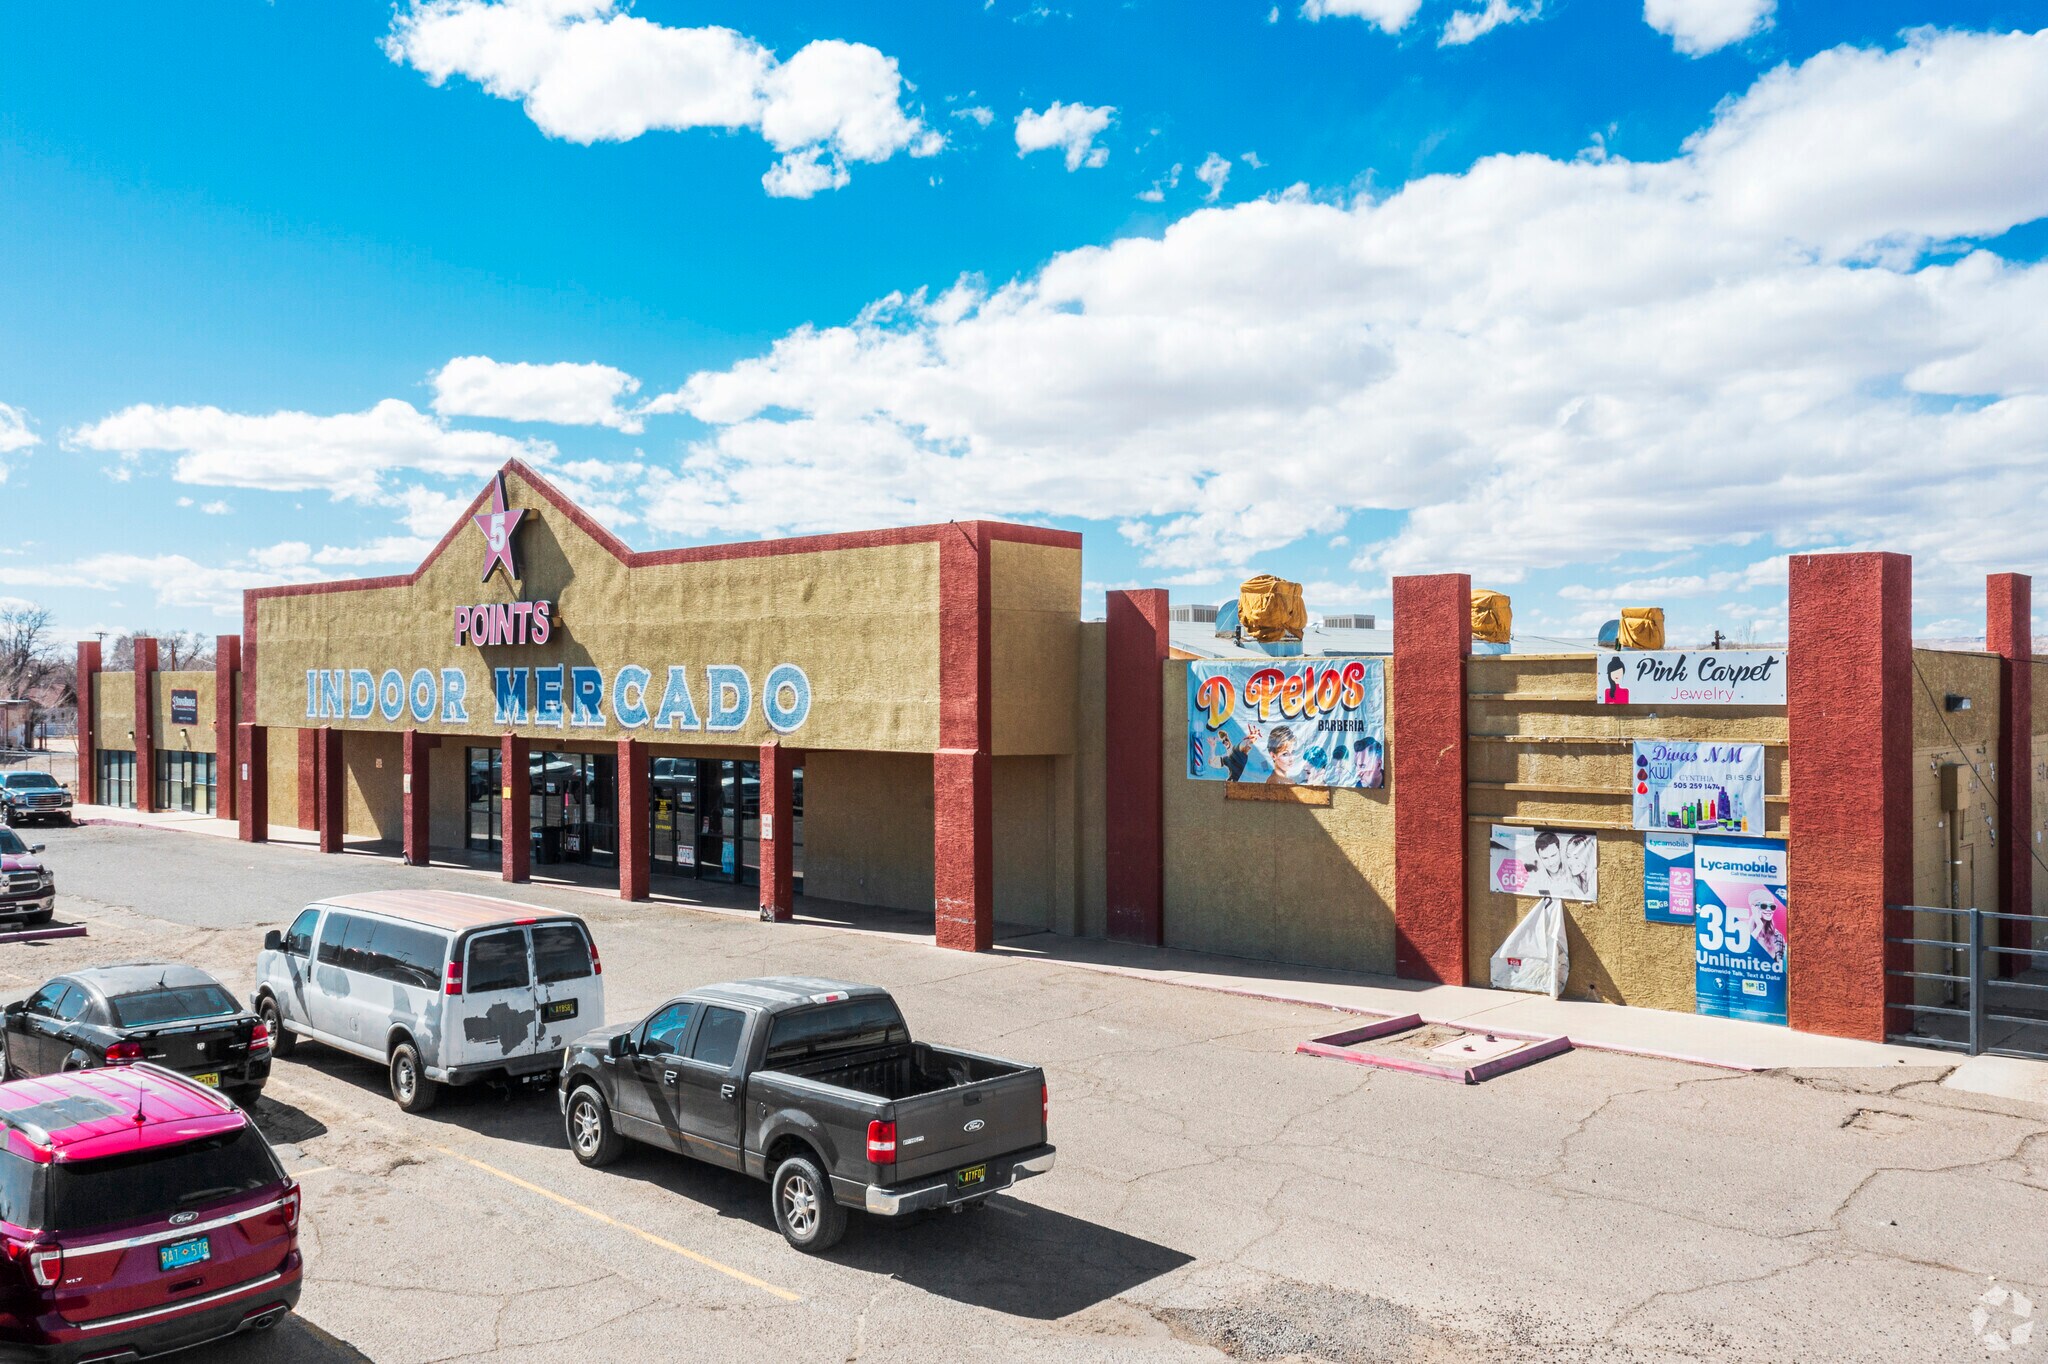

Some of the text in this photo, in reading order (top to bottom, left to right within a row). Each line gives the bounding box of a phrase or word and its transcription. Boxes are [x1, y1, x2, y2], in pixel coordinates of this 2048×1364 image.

[489, 513, 506, 552] 5
[455, 601, 552, 646] POINTS
[1637, 654, 1779, 688] Pink Carpet
[306, 664, 811, 733] INDOOR MERCADO
[1195, 675, 1236, 731] D
[1671, 687, 1735, 702] Jewelry
[1680, 774, 1715, 783] CYNTHIA
[1689, 782, 1703, 790] 259
[1701, 857, 1777, 874] Lycamobile
[1696, 949, 1784, 973] Unlimited
[1700, 966, 1731, 975] Nationwide
[174, 1213, 195, 1223] Ford
